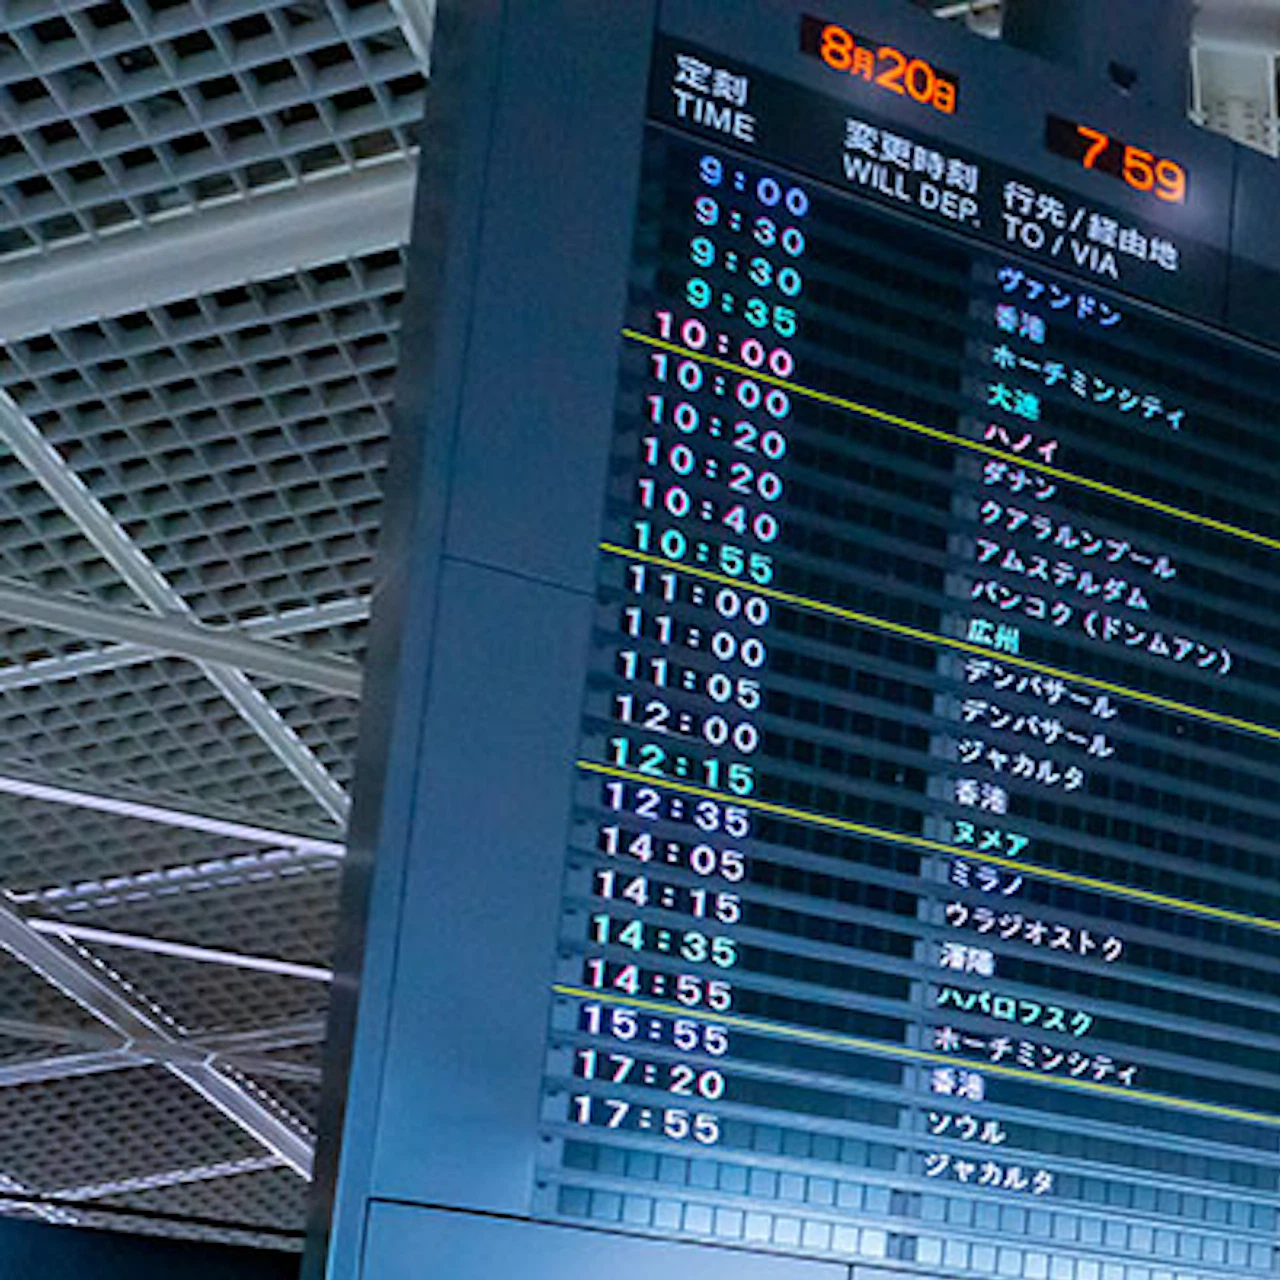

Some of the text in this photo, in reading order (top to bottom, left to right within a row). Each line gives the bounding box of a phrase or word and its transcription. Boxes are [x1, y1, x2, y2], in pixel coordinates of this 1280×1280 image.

[674, 50, 749, 107] 定刻
[671, 87, 756, 144] TIME
[697, 152, 811, 220] 9:00
[844, 116, 979, 196] 変更時刻
[841, 152, 982, 230] WILL DEP.
[693, 193, 807, 260] 9:30
[1001, 213, 1120, 282] TO VIA
[689, 234, 803, 300] 9:30
[685, 275, 800, 340] 9:35
[653, 307, 796, 381] 10:00
[648, 349, 792, 422] 10:00
[644, 391, 788, 463] 10:20
[983, 417, 1058, 467] ハノイ
[639, 433, 784, 504] 10:20
[635, 476, 780, 545] 10:40
[631, 519, 776, 587] 10:55
[626, 561, 772, 629] 11:00
[622, 605, 769, 671] 11:00
[617, 648, 765, 713] 11:05
[613, 691, 761, 755] 12:00
[608, 735, 756, 798] 12:15
[604, 779, 752, 841] 12:35
[599, 823, 748, 884] 14:05
[594, 868, 744, 927] 14:15
[590, 913, 740, 971] 14:35
[585, 958, 736, 1015] 14:55
[581, 1003, 732, 1058] 15:55
[576, 1048, 728, 1103] 17:20
[571, 1094, 724, 1147] 17:55
